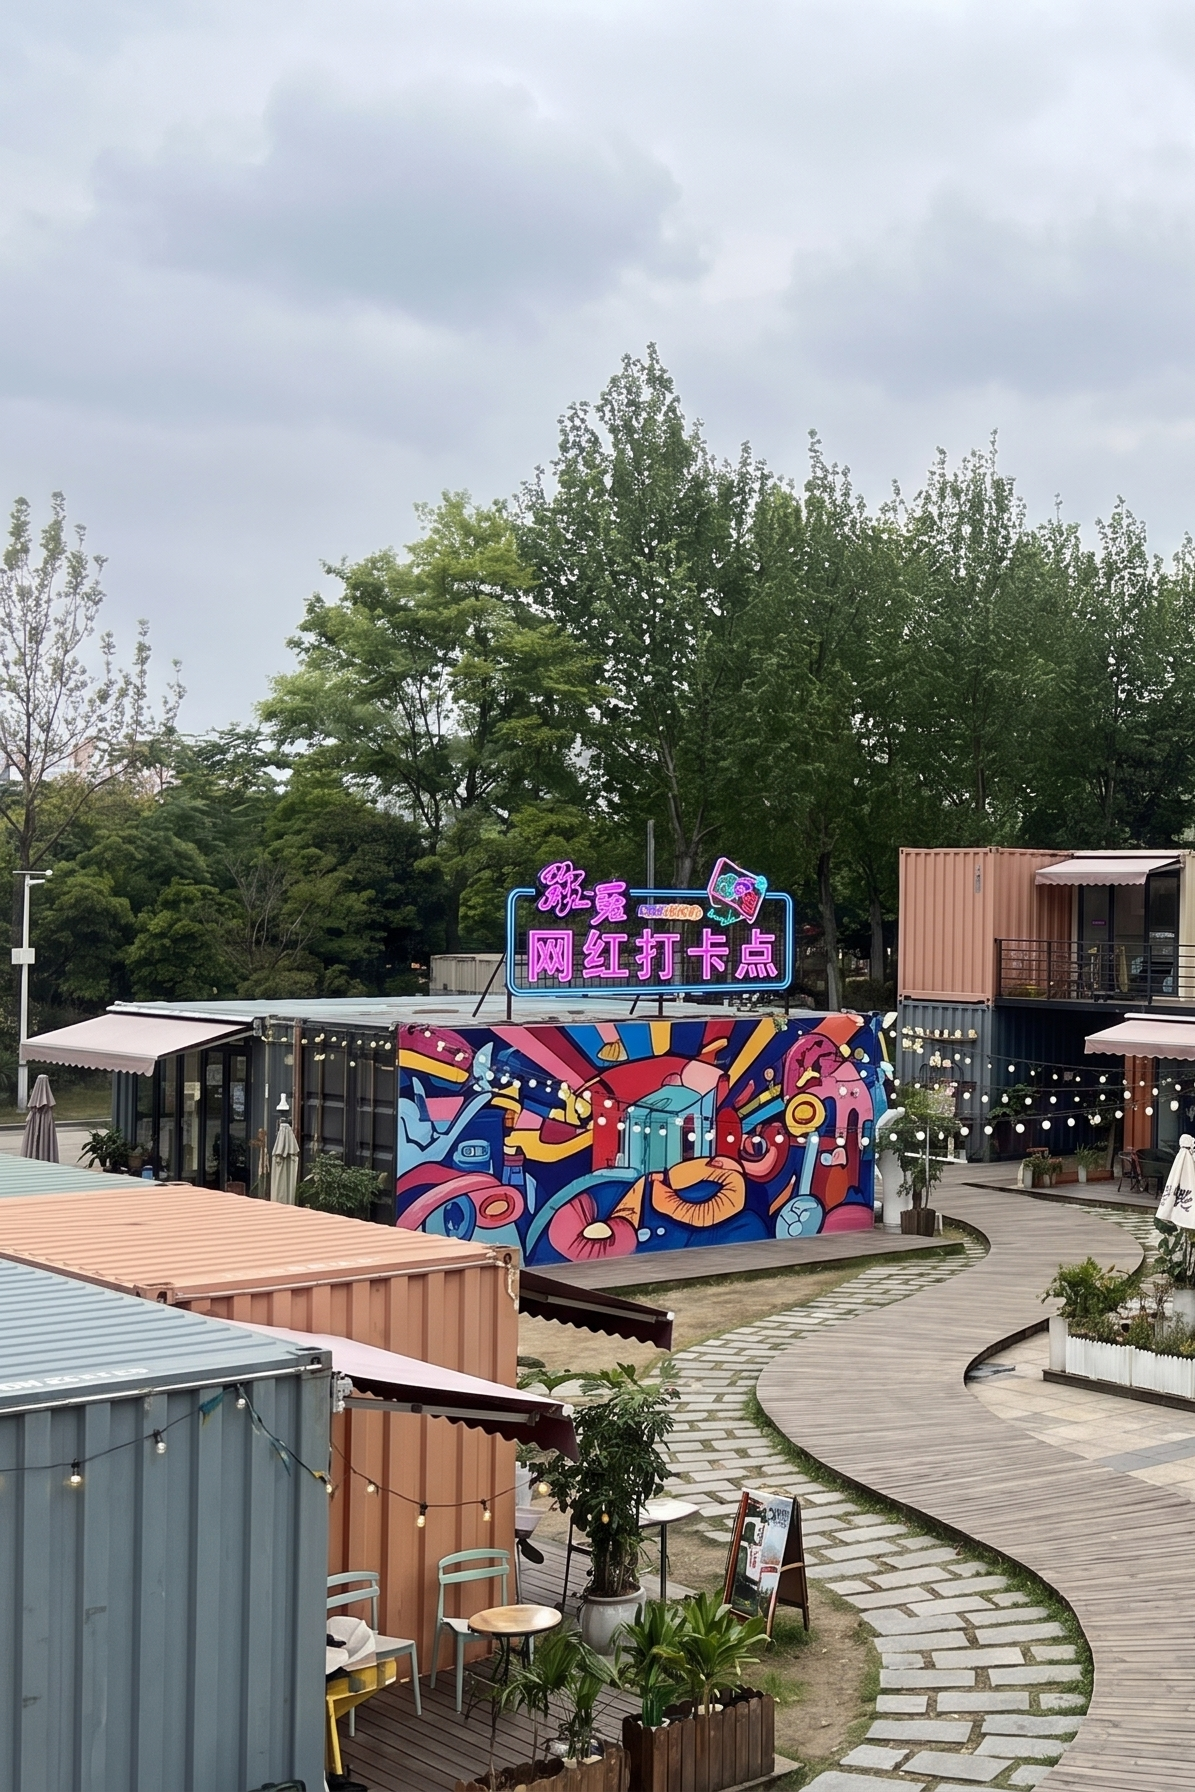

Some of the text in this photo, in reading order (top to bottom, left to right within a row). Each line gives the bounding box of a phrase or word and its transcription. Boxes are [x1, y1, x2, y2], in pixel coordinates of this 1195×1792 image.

[528, 928, 779, 983] 网红打卡点
